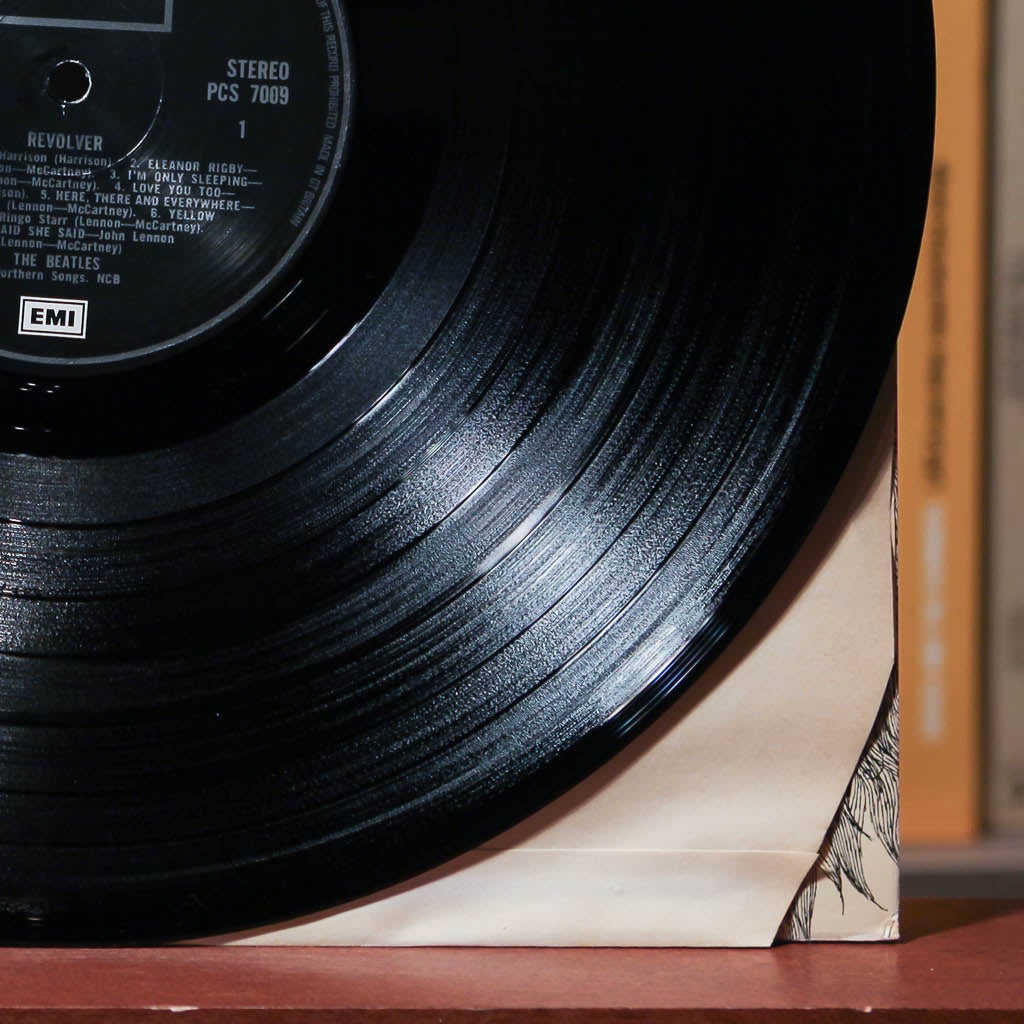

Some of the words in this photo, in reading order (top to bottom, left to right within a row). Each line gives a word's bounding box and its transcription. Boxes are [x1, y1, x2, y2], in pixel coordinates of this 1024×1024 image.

[319, 9, 334, 32] THIS
[226, 58, 290, 80] STEREO
[207, 82, 240, 102] PCS
[249, 84, 290, 105] 7009
[238, 120, 246, 139] 1
[27, 131, 103, 151] REVOLVER
[0, 151, 47, 163] Harrison
[148, 159, 200, 172] ELEANOR
[128, 170, 146, 181] I'M
[154, 171, 184, 184] ONLY
[132, 183, 161, 195] LOVE
[169, 184, 192, 196] YOU
[95, 193, 131, 205] THERE
[135, 194, 159, 206] AND
[39, 214, 68, 225] Starr
[169, 209, 216, 222] YELLOW
[28, 226, 51, 237] SHE
[132, 231, 175, 244] Lennon
[14, 253, 37, 267] THE
[46, 254, 101, 271] BEATLES
[96, 274, 121, 285] NCB
[30, 308, 75, 327] EMI
